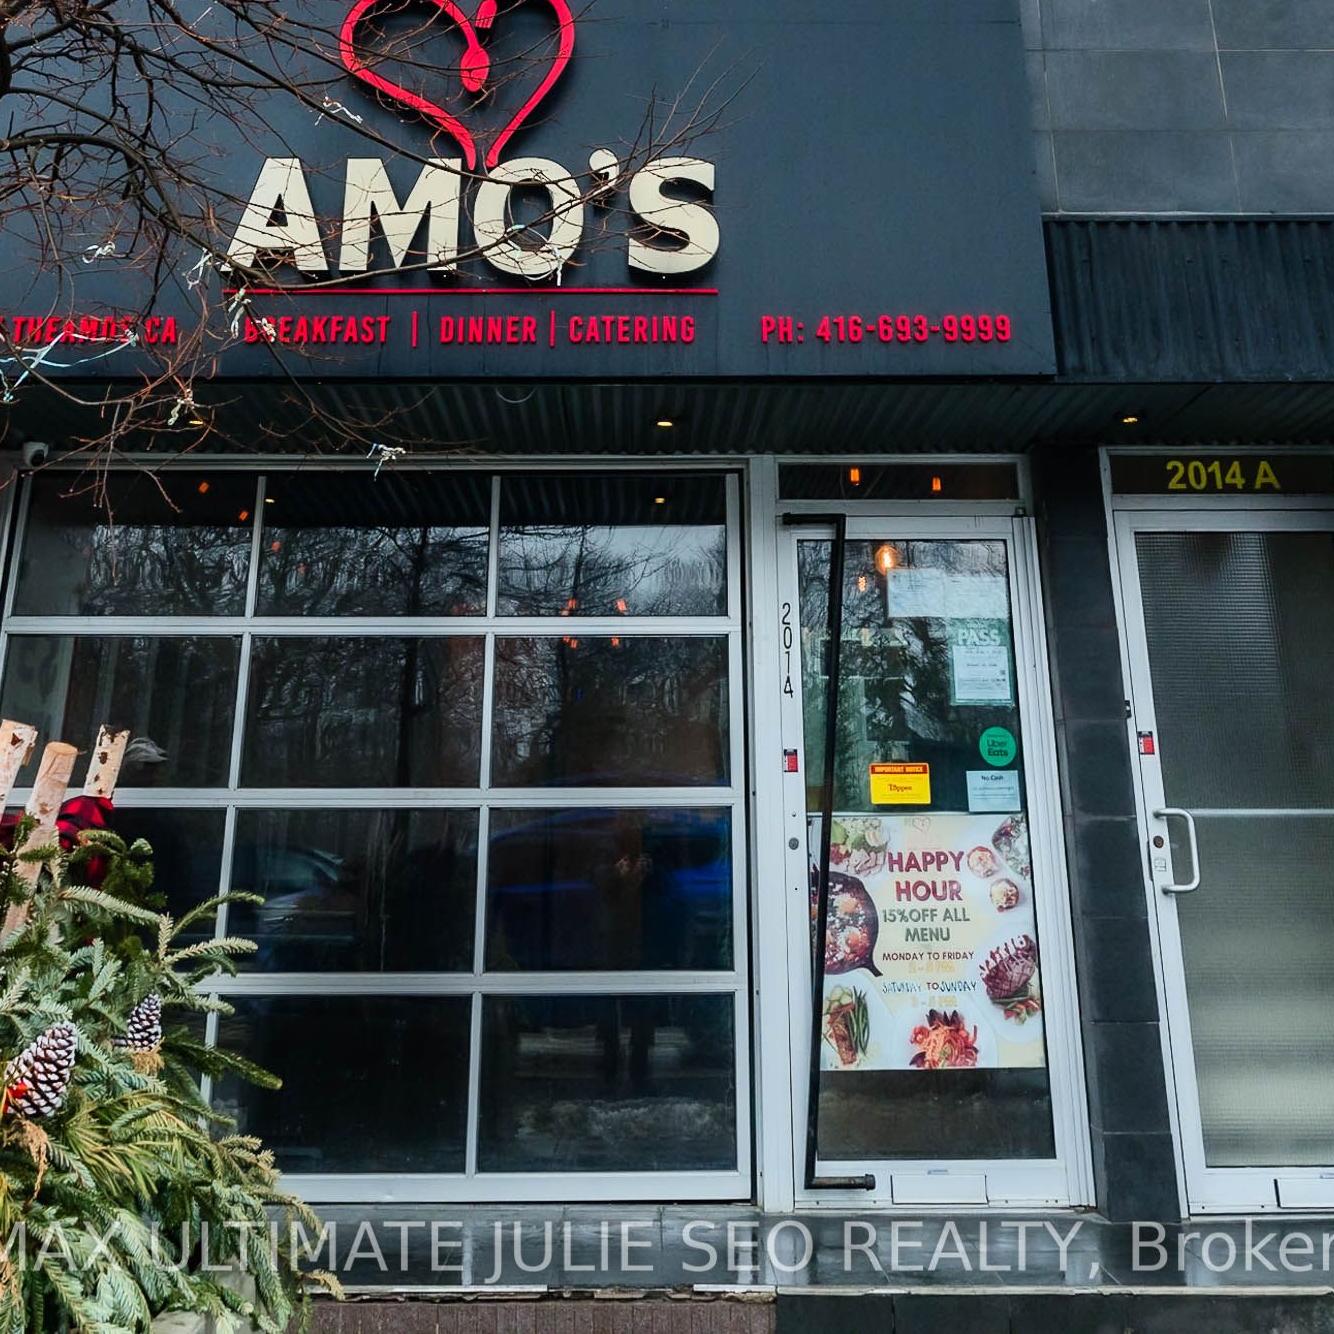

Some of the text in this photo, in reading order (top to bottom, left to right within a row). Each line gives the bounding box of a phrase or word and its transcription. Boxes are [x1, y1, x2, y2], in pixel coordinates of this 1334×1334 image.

[224, 149, 721, 284] AMO'S
[244, 315, 696, 344] BREAKFAST DINNER CATERING
[760, 315, 1013, 345] PH: 416-693-9999
[1167, 460, 1282, 490] 2014 A
[958, 628, 1002, 646] PASS
[987, 747, 1009, 757] Eats
[888, 850, 964, 873] HAPPY
[895, 880, 963, 901] HOUR
[943, 907, 970, 922] ALL
[905, 927, 950, 942] MENU
[882, 951, 974, 961] MONDAY TO FRIDAY
[926, 982, 939, 990] TO
